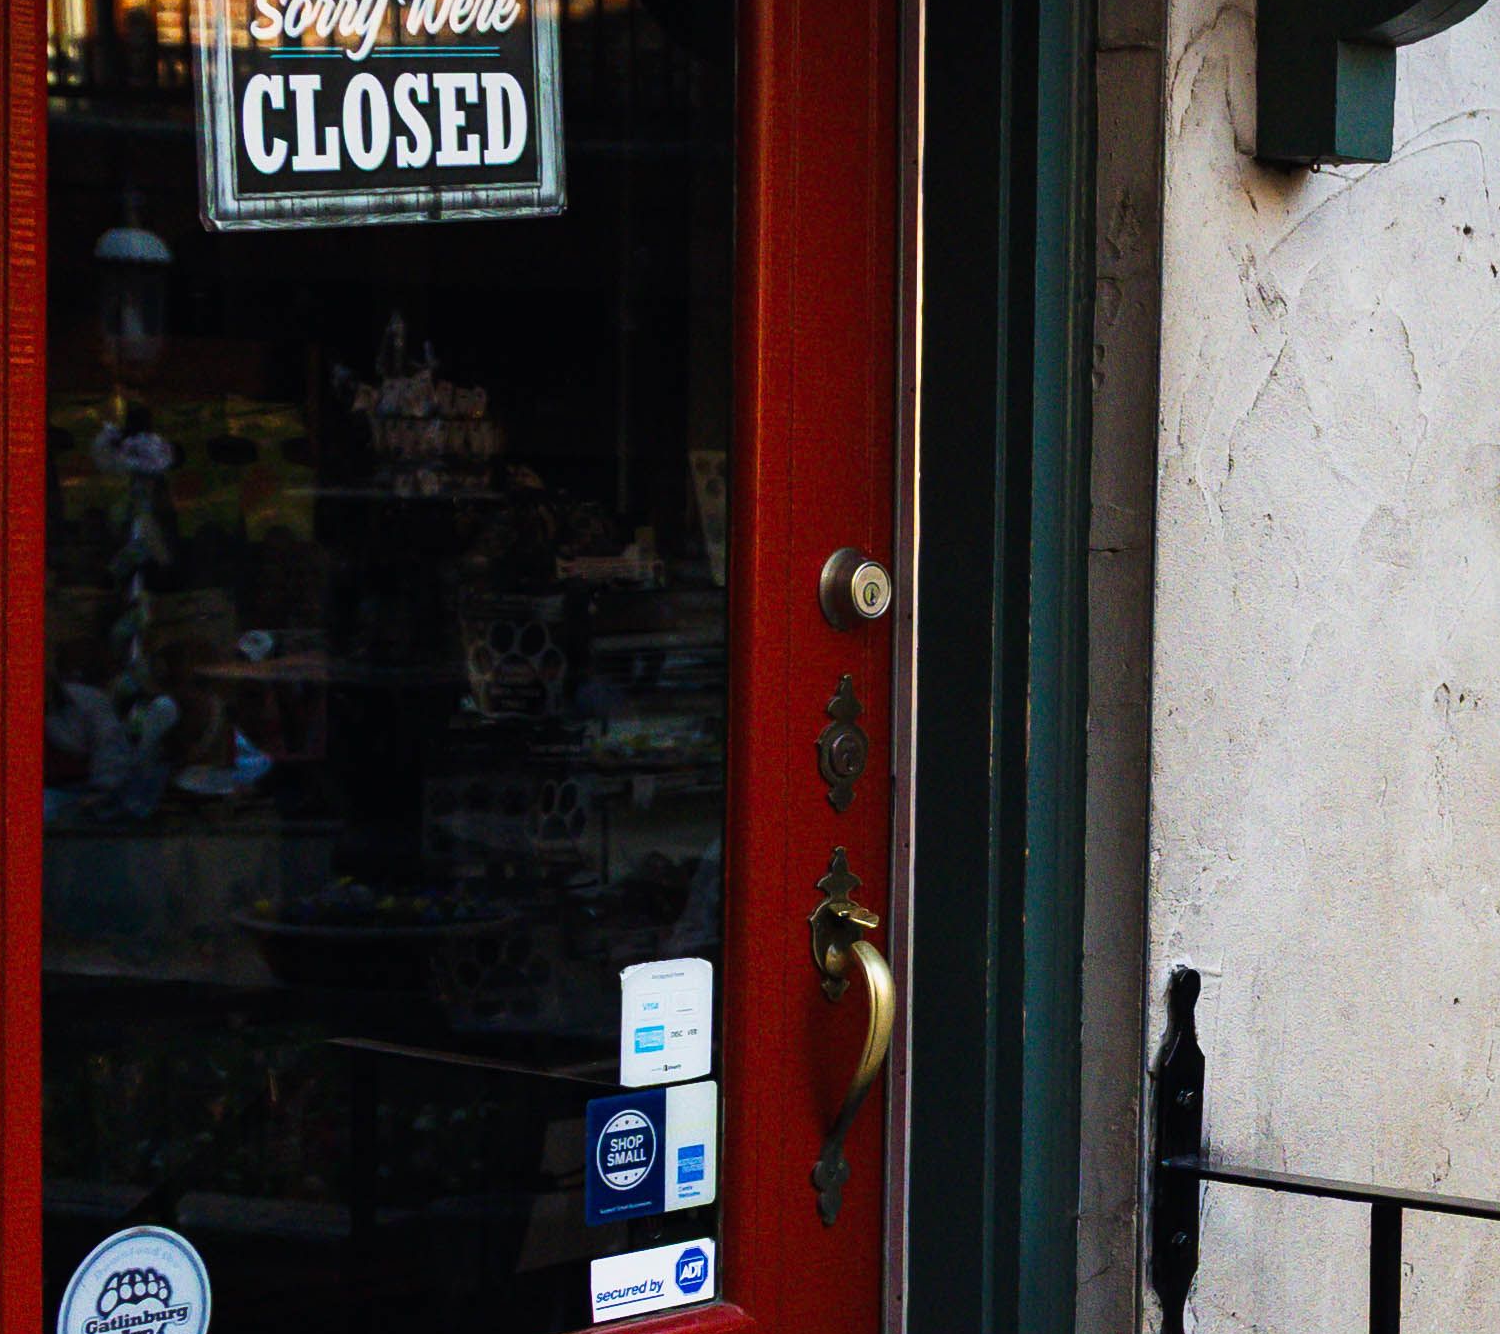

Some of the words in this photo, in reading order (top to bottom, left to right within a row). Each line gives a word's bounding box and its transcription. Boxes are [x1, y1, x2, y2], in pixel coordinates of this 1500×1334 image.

[242, 71, 528, 175] CLOSED
[610, 1134, 644, 1152] SHOP
[607, 1148, 647, 1167] SMALL
[680, 1260, 705, 1281] ADT
[596, 1280, 648, 1303] secured
[649, 1278, 664, 1293] by
